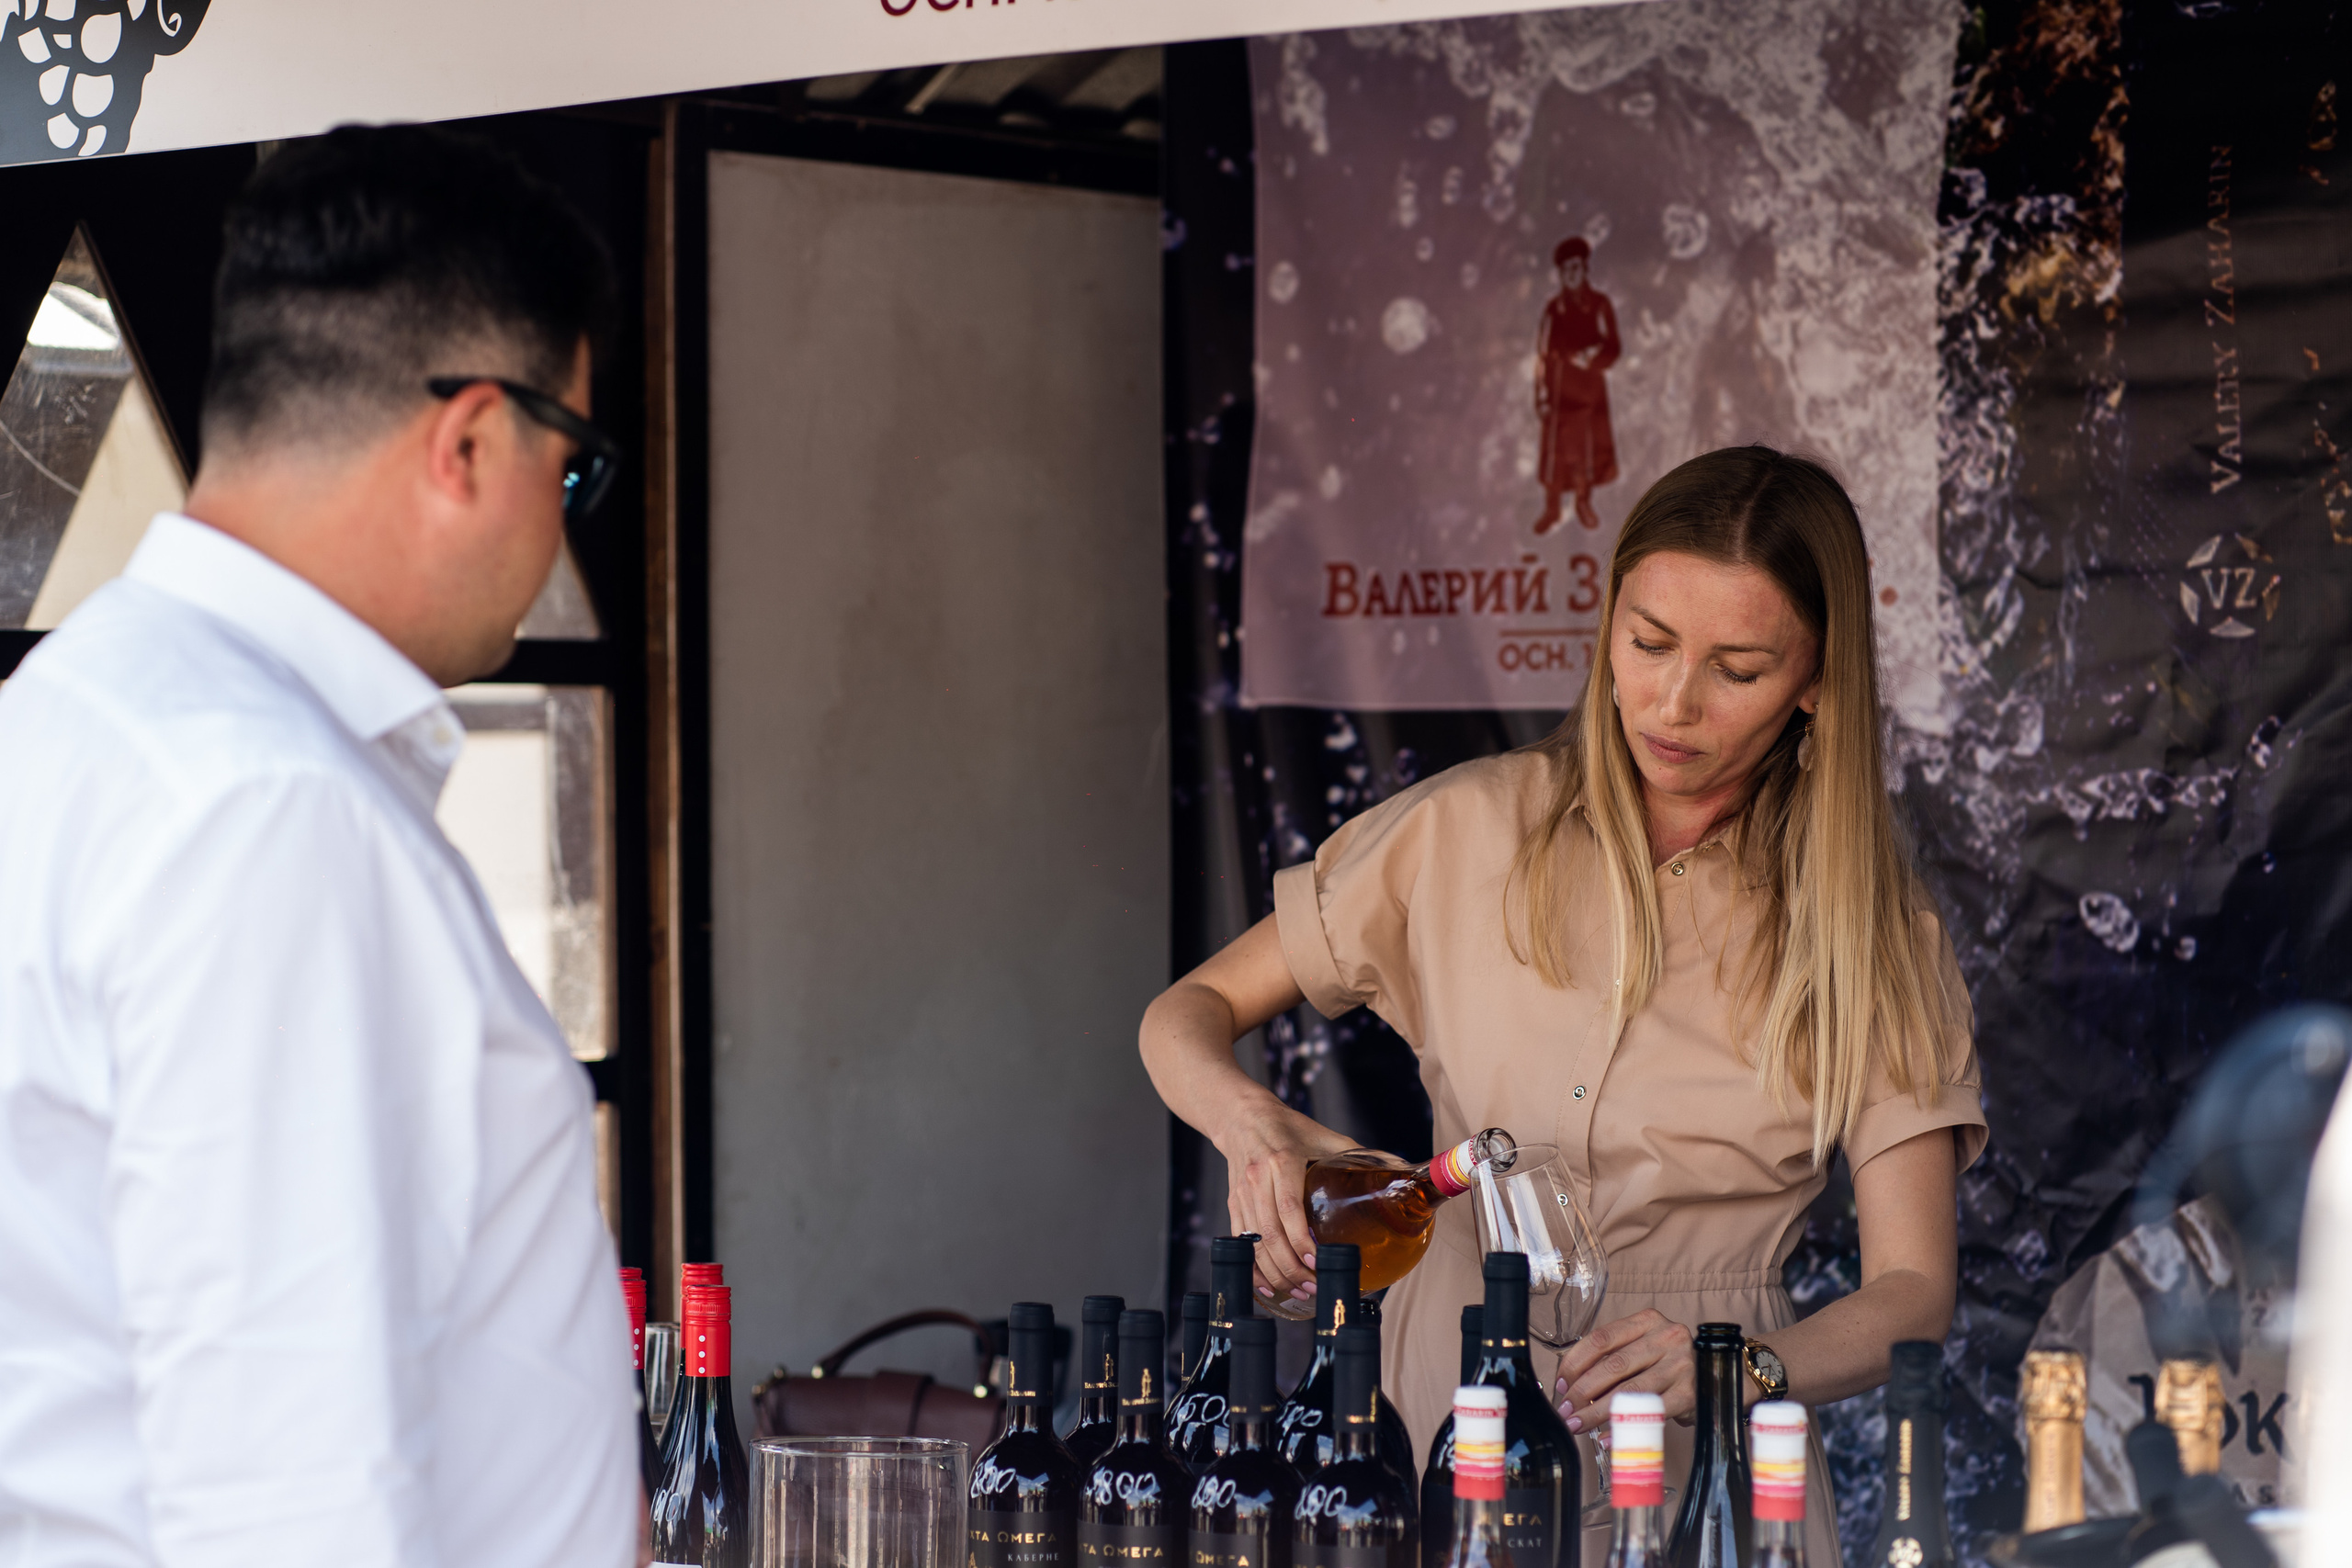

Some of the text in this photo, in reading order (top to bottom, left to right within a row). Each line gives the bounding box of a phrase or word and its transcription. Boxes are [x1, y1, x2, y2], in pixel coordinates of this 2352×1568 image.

[2204, 144, 2242, 494] VALERY ZAHARIN
[2201, 567, 2257, 610] VZ
